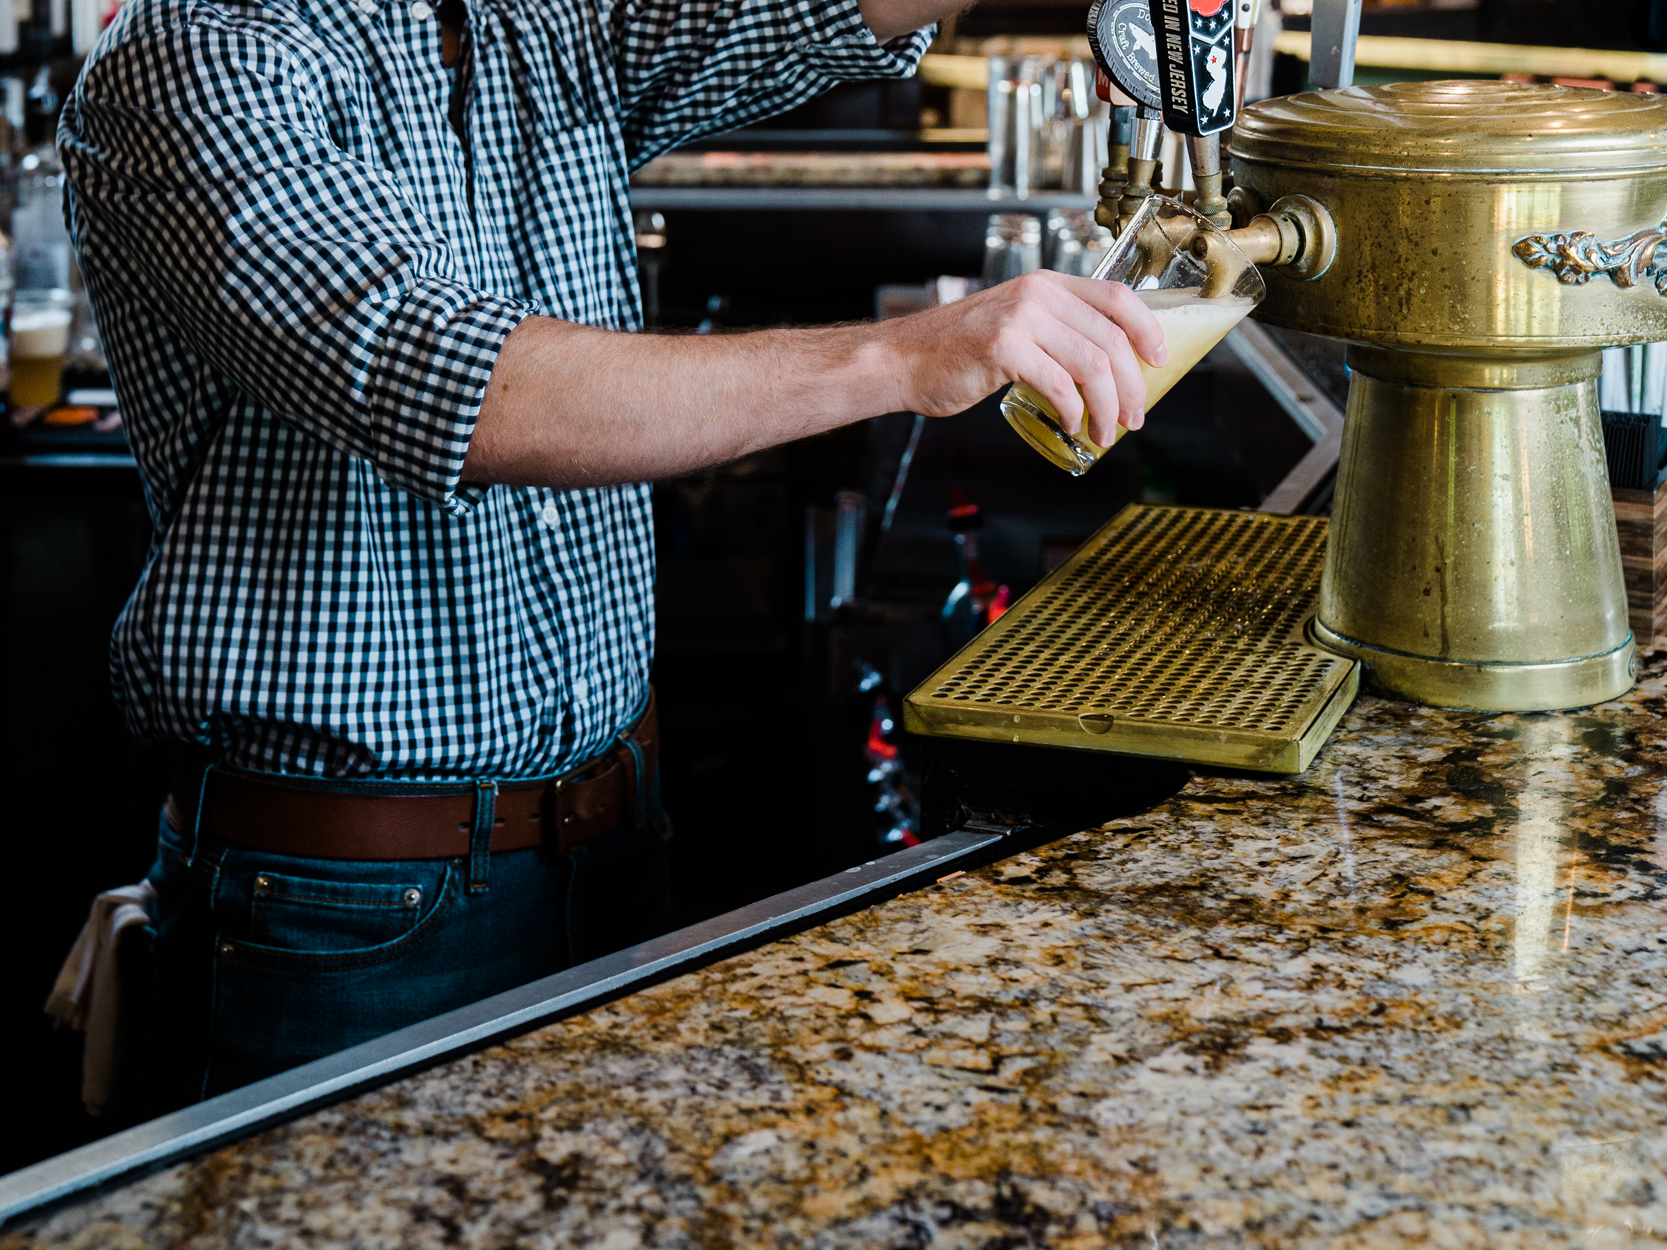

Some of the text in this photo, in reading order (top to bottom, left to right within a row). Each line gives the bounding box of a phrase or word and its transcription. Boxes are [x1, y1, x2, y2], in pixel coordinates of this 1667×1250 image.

[1118, 22, 1130, 50] Craft
[1164, 15, 1181, 31] IN
[1166, 33, 1184, 64] NEW
[1127, 50, 1156, 83] Brewed
[1169, 64, 1189, 115] JERSEY
